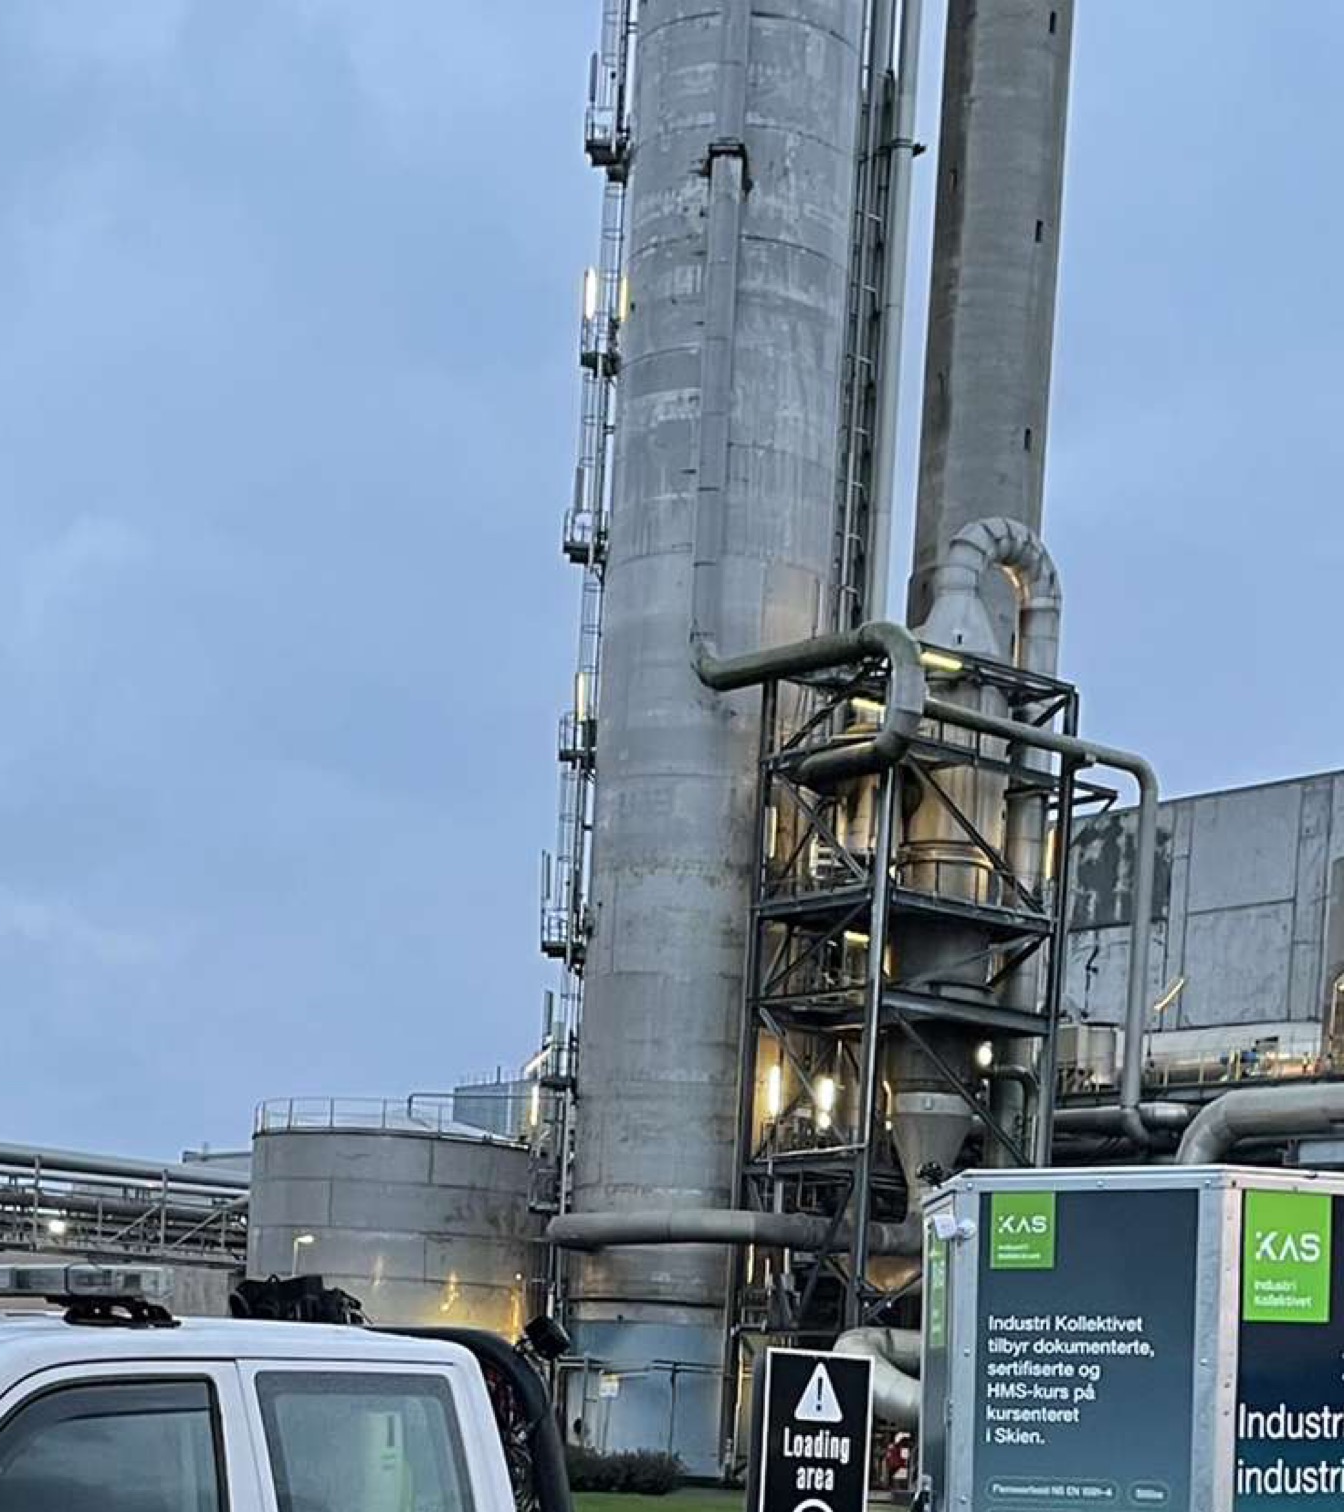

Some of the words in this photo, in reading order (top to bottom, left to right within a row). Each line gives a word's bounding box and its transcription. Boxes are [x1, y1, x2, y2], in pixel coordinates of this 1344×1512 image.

[998, 1215, 1047, 1234] KAS
[1256, 1231, 1321, 1262] KAS
[988, 1315, 1050, 1332] Industri
[1055, 1315, 1144, 1332] Kollektivet
[988, 1339, 1029, 1357] tilbyr
[1033, 1339, 1155, 1358] dokumenterte,
[987, 1361, 1074, 1377] sertifiserte
[1078, 1364, 1101, 1380] og
[987, 1382, 1069, 1399] HMS-kurs
[1073, 1383, 1096, 1402] på
[986, 1405, 1080, 1422] kursenteret
[994, 1427, 1046, 1444] Skien.
[783, 1427, 850, 1465] Loading
[795, 1466, 834, 1491] area
